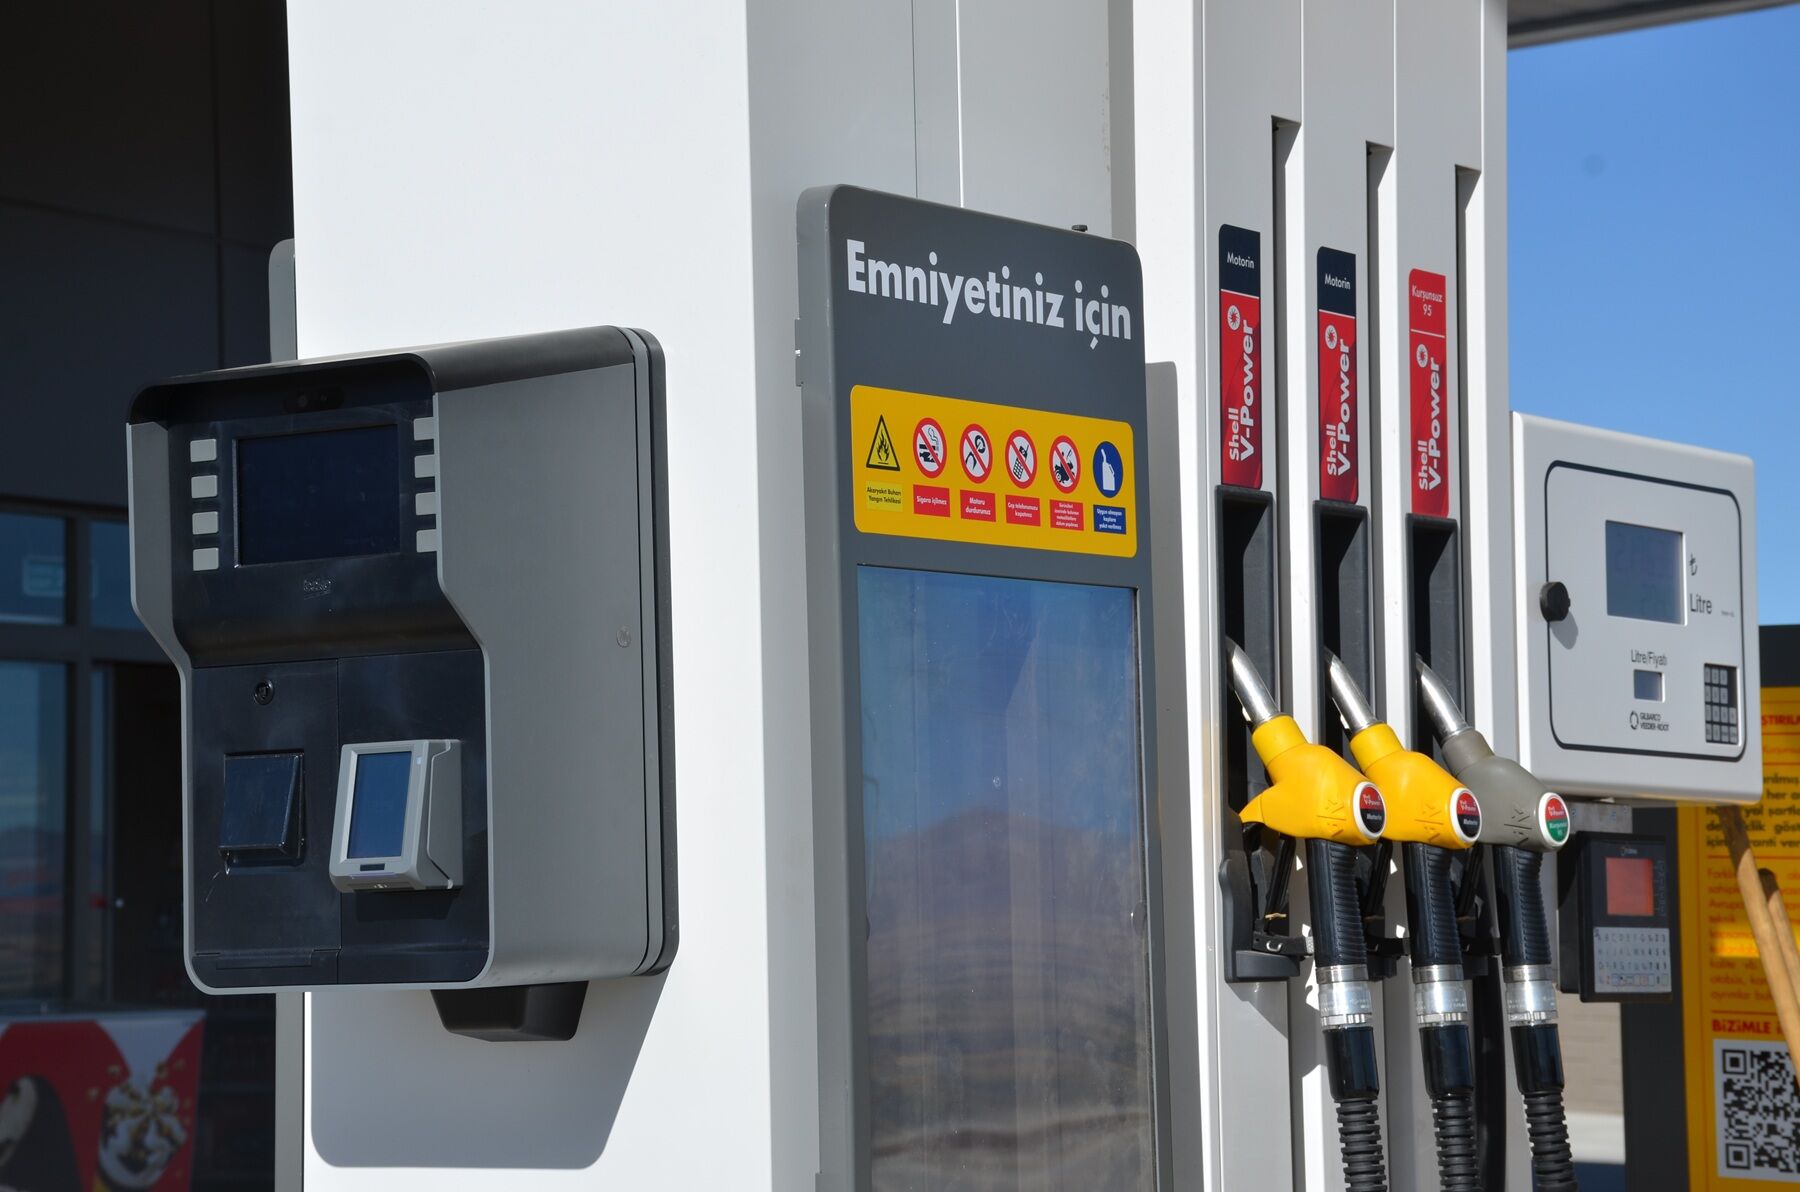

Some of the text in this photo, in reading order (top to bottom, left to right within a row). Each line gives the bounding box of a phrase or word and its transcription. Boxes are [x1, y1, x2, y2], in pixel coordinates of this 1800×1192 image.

[1226, 251, 1255, 269] Motorin
[1324, 273, 1351, 290] Motorin
[846, 239, 1131, 350] Emniyetiniz için
[1411, 285, 1443, 303] Kurşunsuz
[1422, 304, 1432, 317] 95
[1240, 319, 1255, 461] V-Power
[1337, 339, 1351, 476] V-Power
[1228, 407, 1239, 461] Shell
[1326, 424, 1337, 475] Shell
[1428, 357, 1441, 491] V-Power
[1418, 440, 1428, 491] Shell
[1690, 593, 1712, 614] Litre
